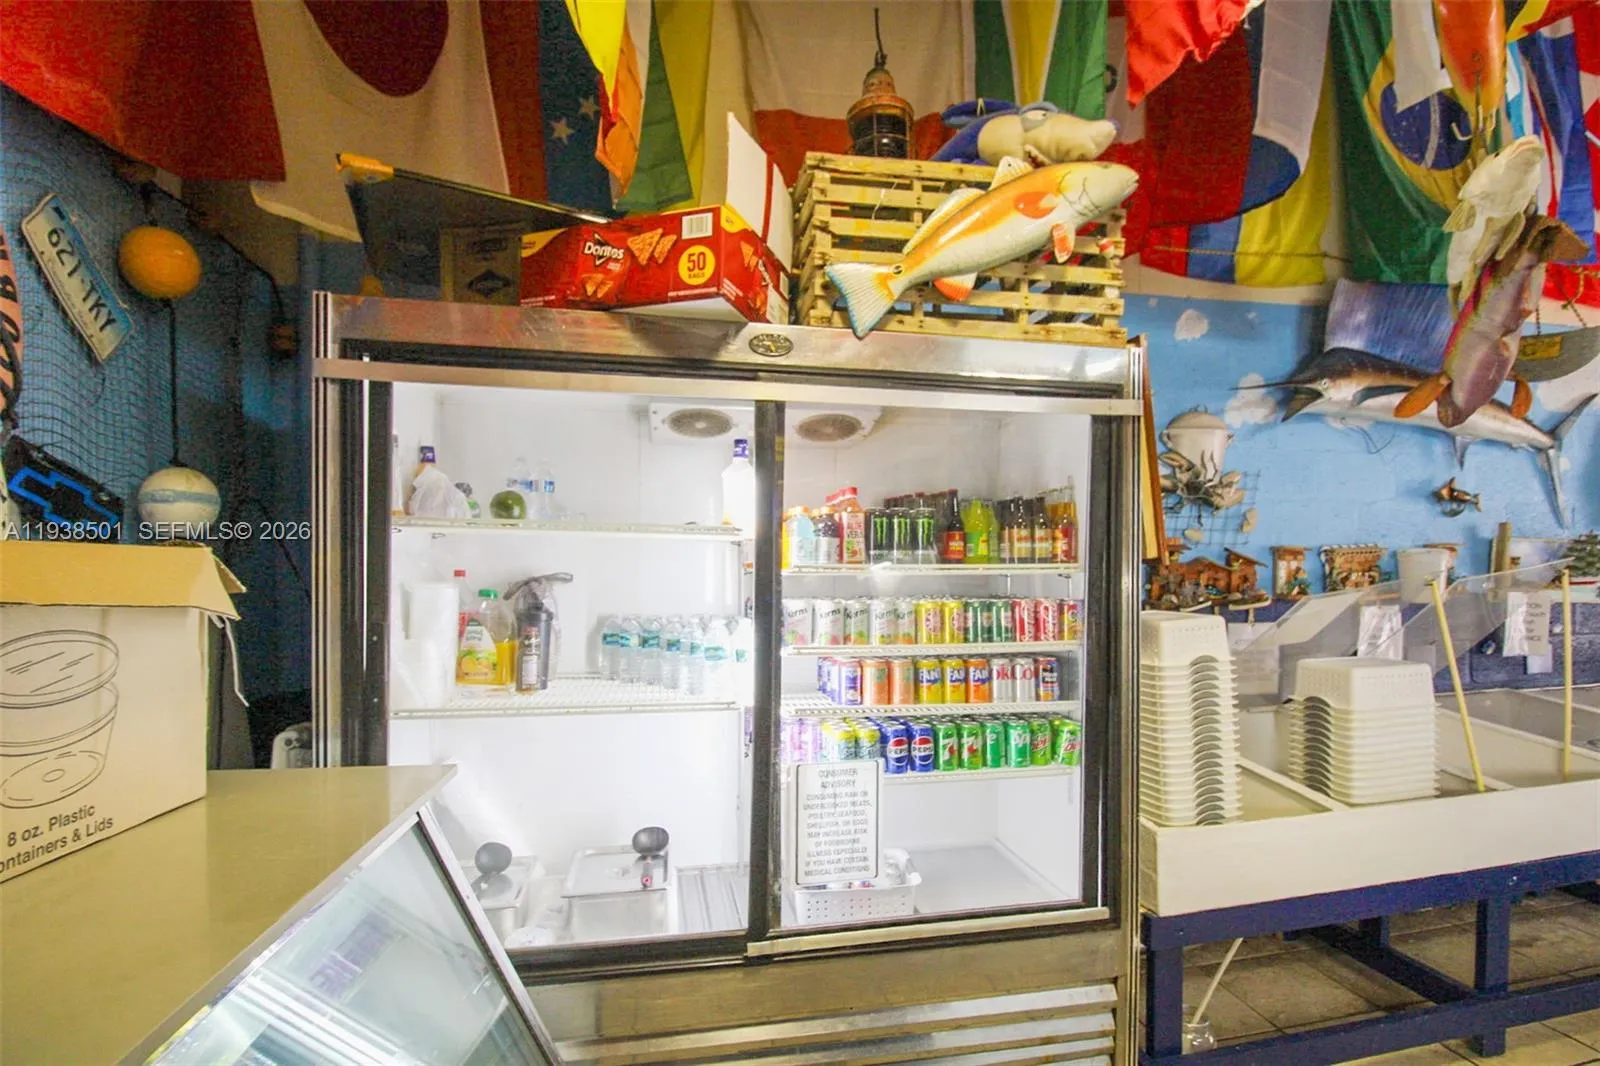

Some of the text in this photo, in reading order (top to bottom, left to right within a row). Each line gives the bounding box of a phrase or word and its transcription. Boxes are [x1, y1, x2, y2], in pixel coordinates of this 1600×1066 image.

[584, 241, 624, 259] Doritos
[687, 252, 706, 272] 50
[7, 804, 95, 848] 8 oz. Plastic
[71, 828, 82, 843] &
[85, 817, 114, 837] Lids
